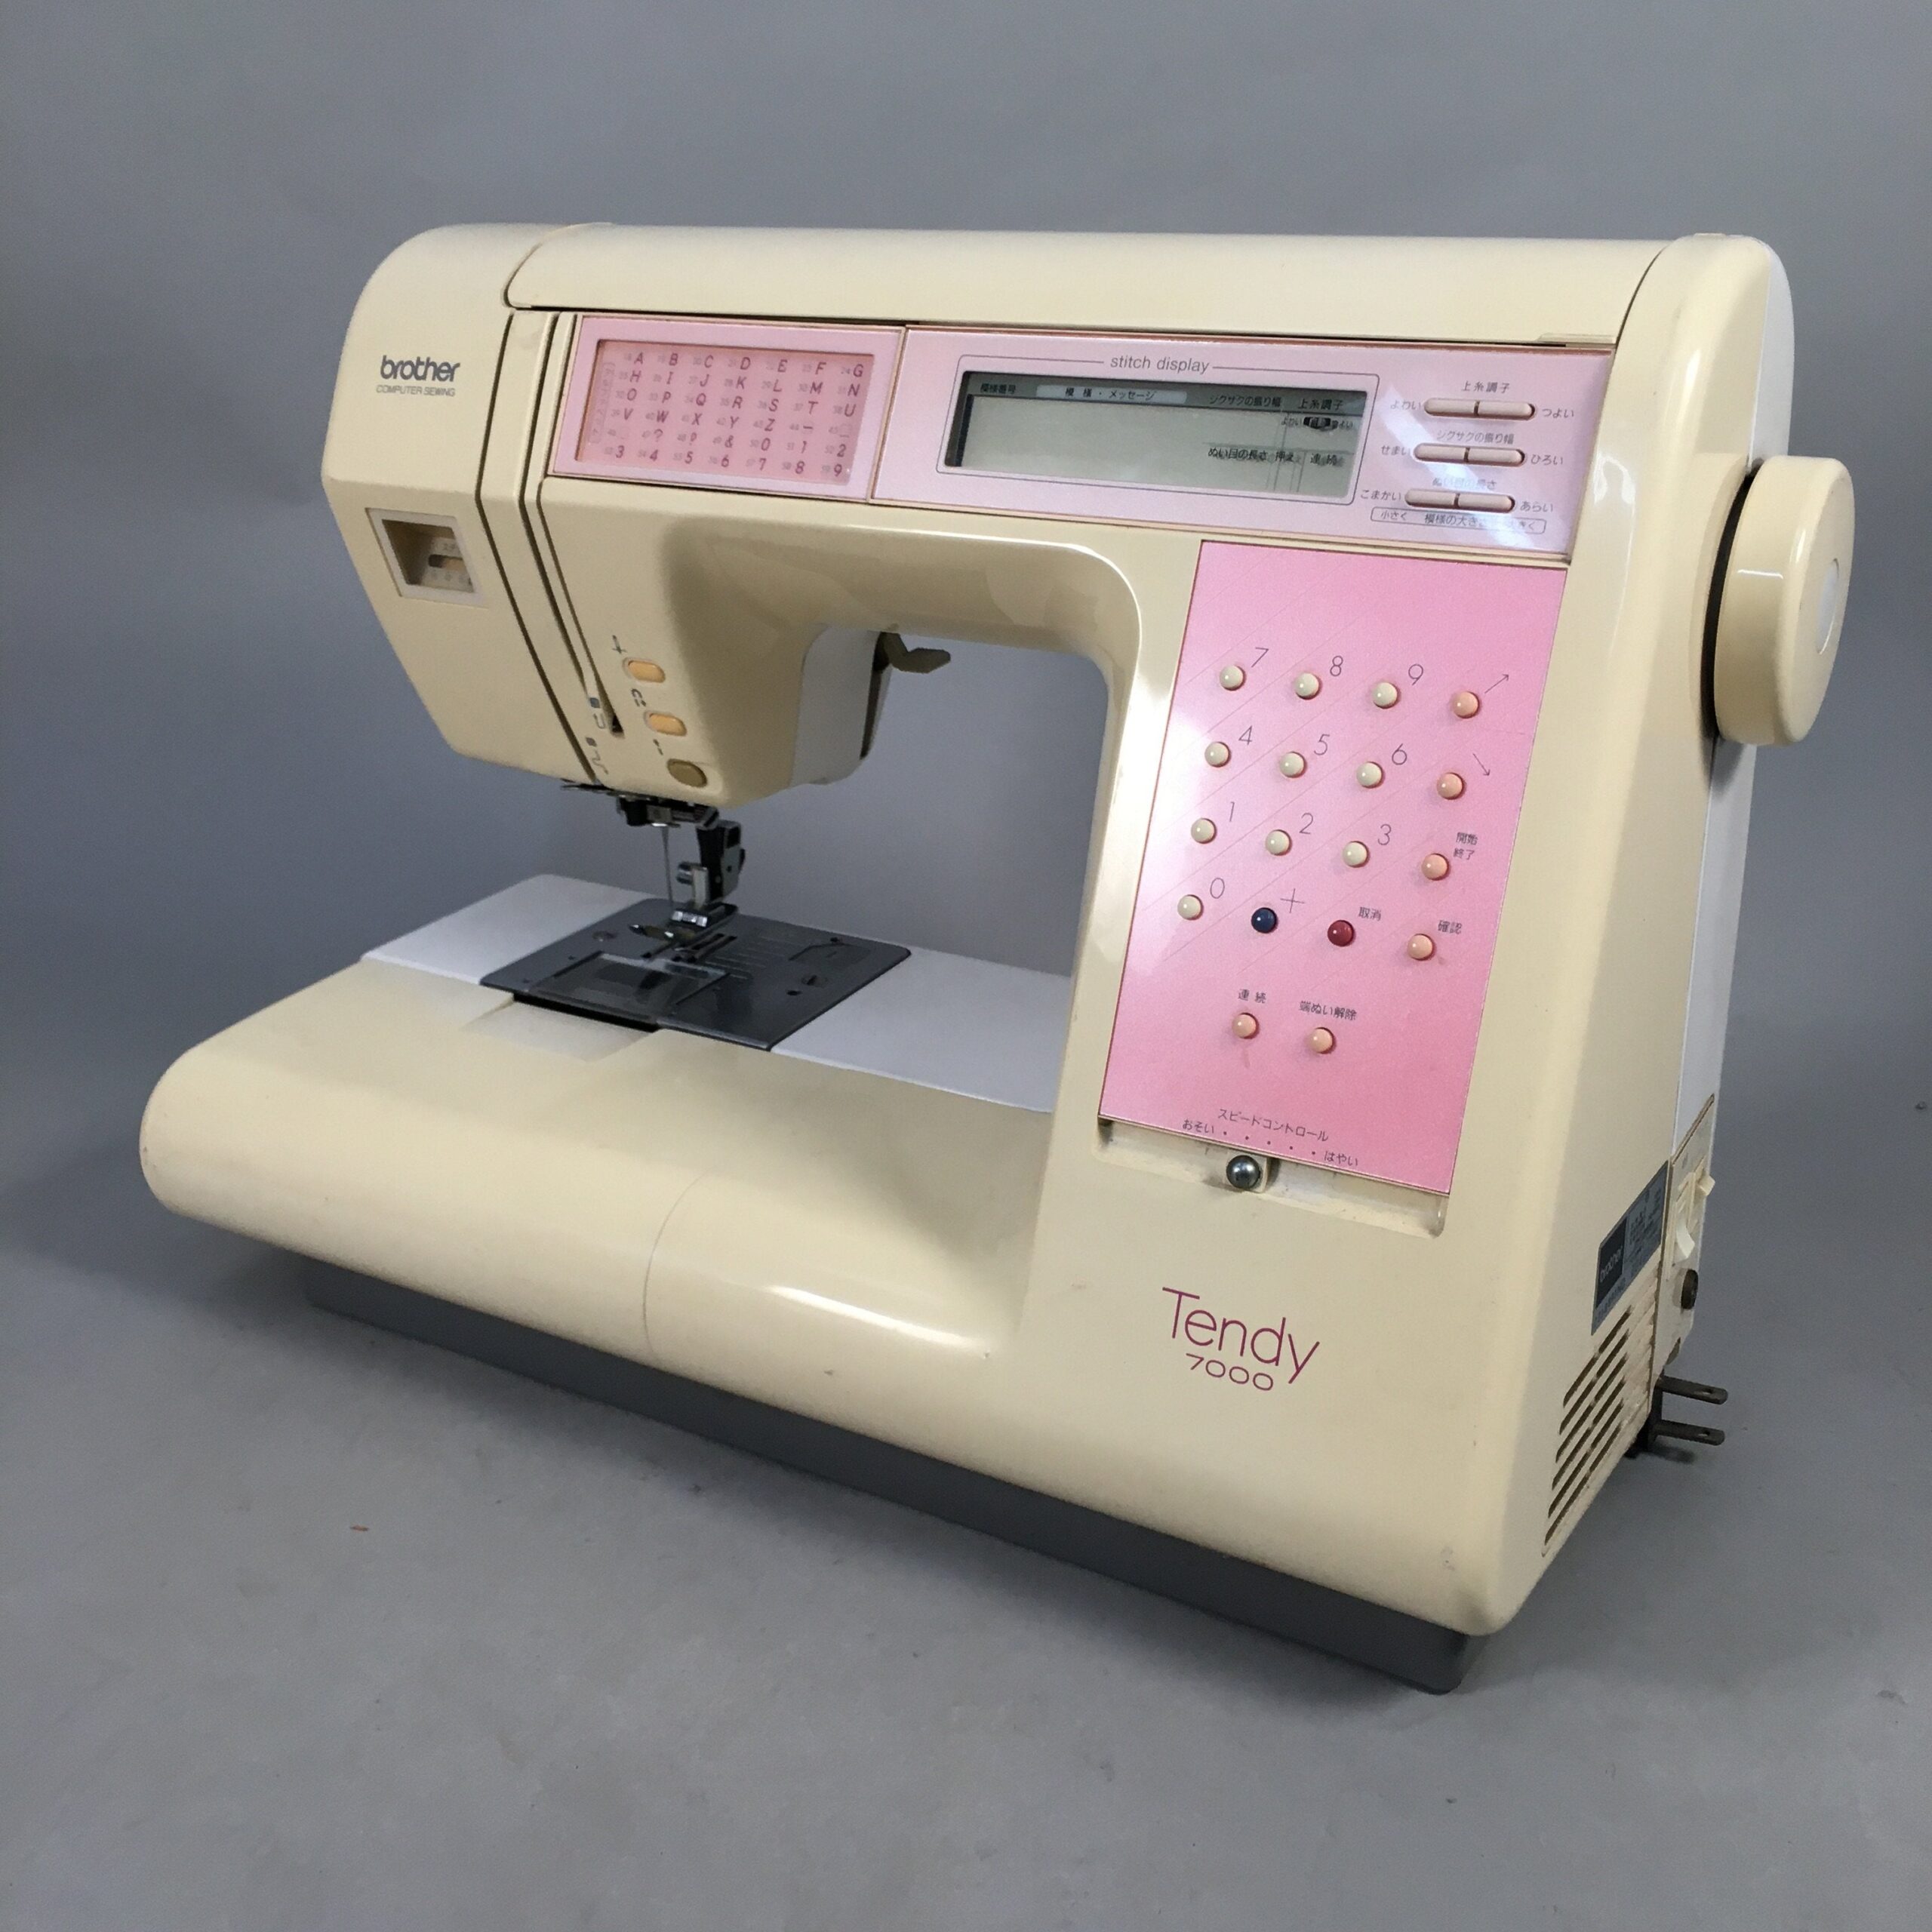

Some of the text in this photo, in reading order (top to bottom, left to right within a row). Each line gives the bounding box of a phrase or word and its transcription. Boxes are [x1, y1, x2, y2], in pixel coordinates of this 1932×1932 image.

[380, 355, 460, 382] brother
[634, 352, 643, 364] A
[669, 353, 678, 365] B
[704, 355, 713, 368] C
[740, 357, 750, 370] D
[778, 359, 788, 372] E
[815, 362, 826, 374] F
[853, 365, 863, 377] G
[1110, 355, 1210, 374] stitch display
[376, 385, 456, 397] COMPUTER SEWING
[629, 371, 641, 382] H
[666, 371, 673, 384] I
[700, 374, 709, 386] J
[736, 376, 746, 389] K
[773, 380, 782, 392] L
[810, 382, 823, 394] M
[848, 383, 860, 396] N
[1461, 381, 1510, 393] 上糸調子
[662, 392, 671, 403] P
[696, 393, 706, 406] Q
[732, 396, 743, 409] R
[769, 399, 779, 411] S
[808, 401, 818, 414] T
[844, 404, 856, 417] U
[1298, 398, 1343, 410] 上糸調子
[1542, 408, 1574, 418] つよい
[624, 408, 633, 420] V
[657, 411, 669, 423] W
[692, 413, 703, 425] X
[731, 416, 740, 429] Y
[764, 418, 775, 431] Z
[654, 429, 663, 441] ?
[724, 435, 734, 448] &
[801, 441, 807, 454] 1
[837, 444, 846, 457] 2
[616, 445, 625, 458] 3
[650, 449, 658, 461] 4
[685, 451, 693, 463] 5
[721, 455, 729, 467] 6
[759, 458, 766, 471] 7
[795, 461, 804, 474] 8
[834, 464, 842, 477] 9
[1531, 453, 1564, 466] ひろい
[1361, 490, 1402, 500] こまかい
[1520, 501, 1553, 512] あらい
[1251, 647, 1269, 668] 7
[1329, 655, 1344, 677] 8
[1408, 663, 1424, 686] 9
[1238, 726, 1253, 746] 4
[1314, 734, 1331, 755] 5
[1392, 743, 1407, 765] 6
[1229, 801, 1235, 822] 1
[1300, 813, 1314, 835] 2
[1378, 824, 1392, 845] 3
[1210, 878, 1226, 899] 0
[1358, 906, 1382, 921] 取消
[1437, 920, 1463, 935] 確認
[1238, 989, 1266, 1004] 連続
[1298, 1000, 1357, 1020] 端ぬい解除
[1182, 1119, 1215, 1134] おそい
[1218, 1109, 1329, 1142] スピードコントロール
[1324, 1151, 1358, 1166] はやい
[1162, 1287, 1320, 1384] Tendy
[1186, 1352, 1274, 1391] 7000
